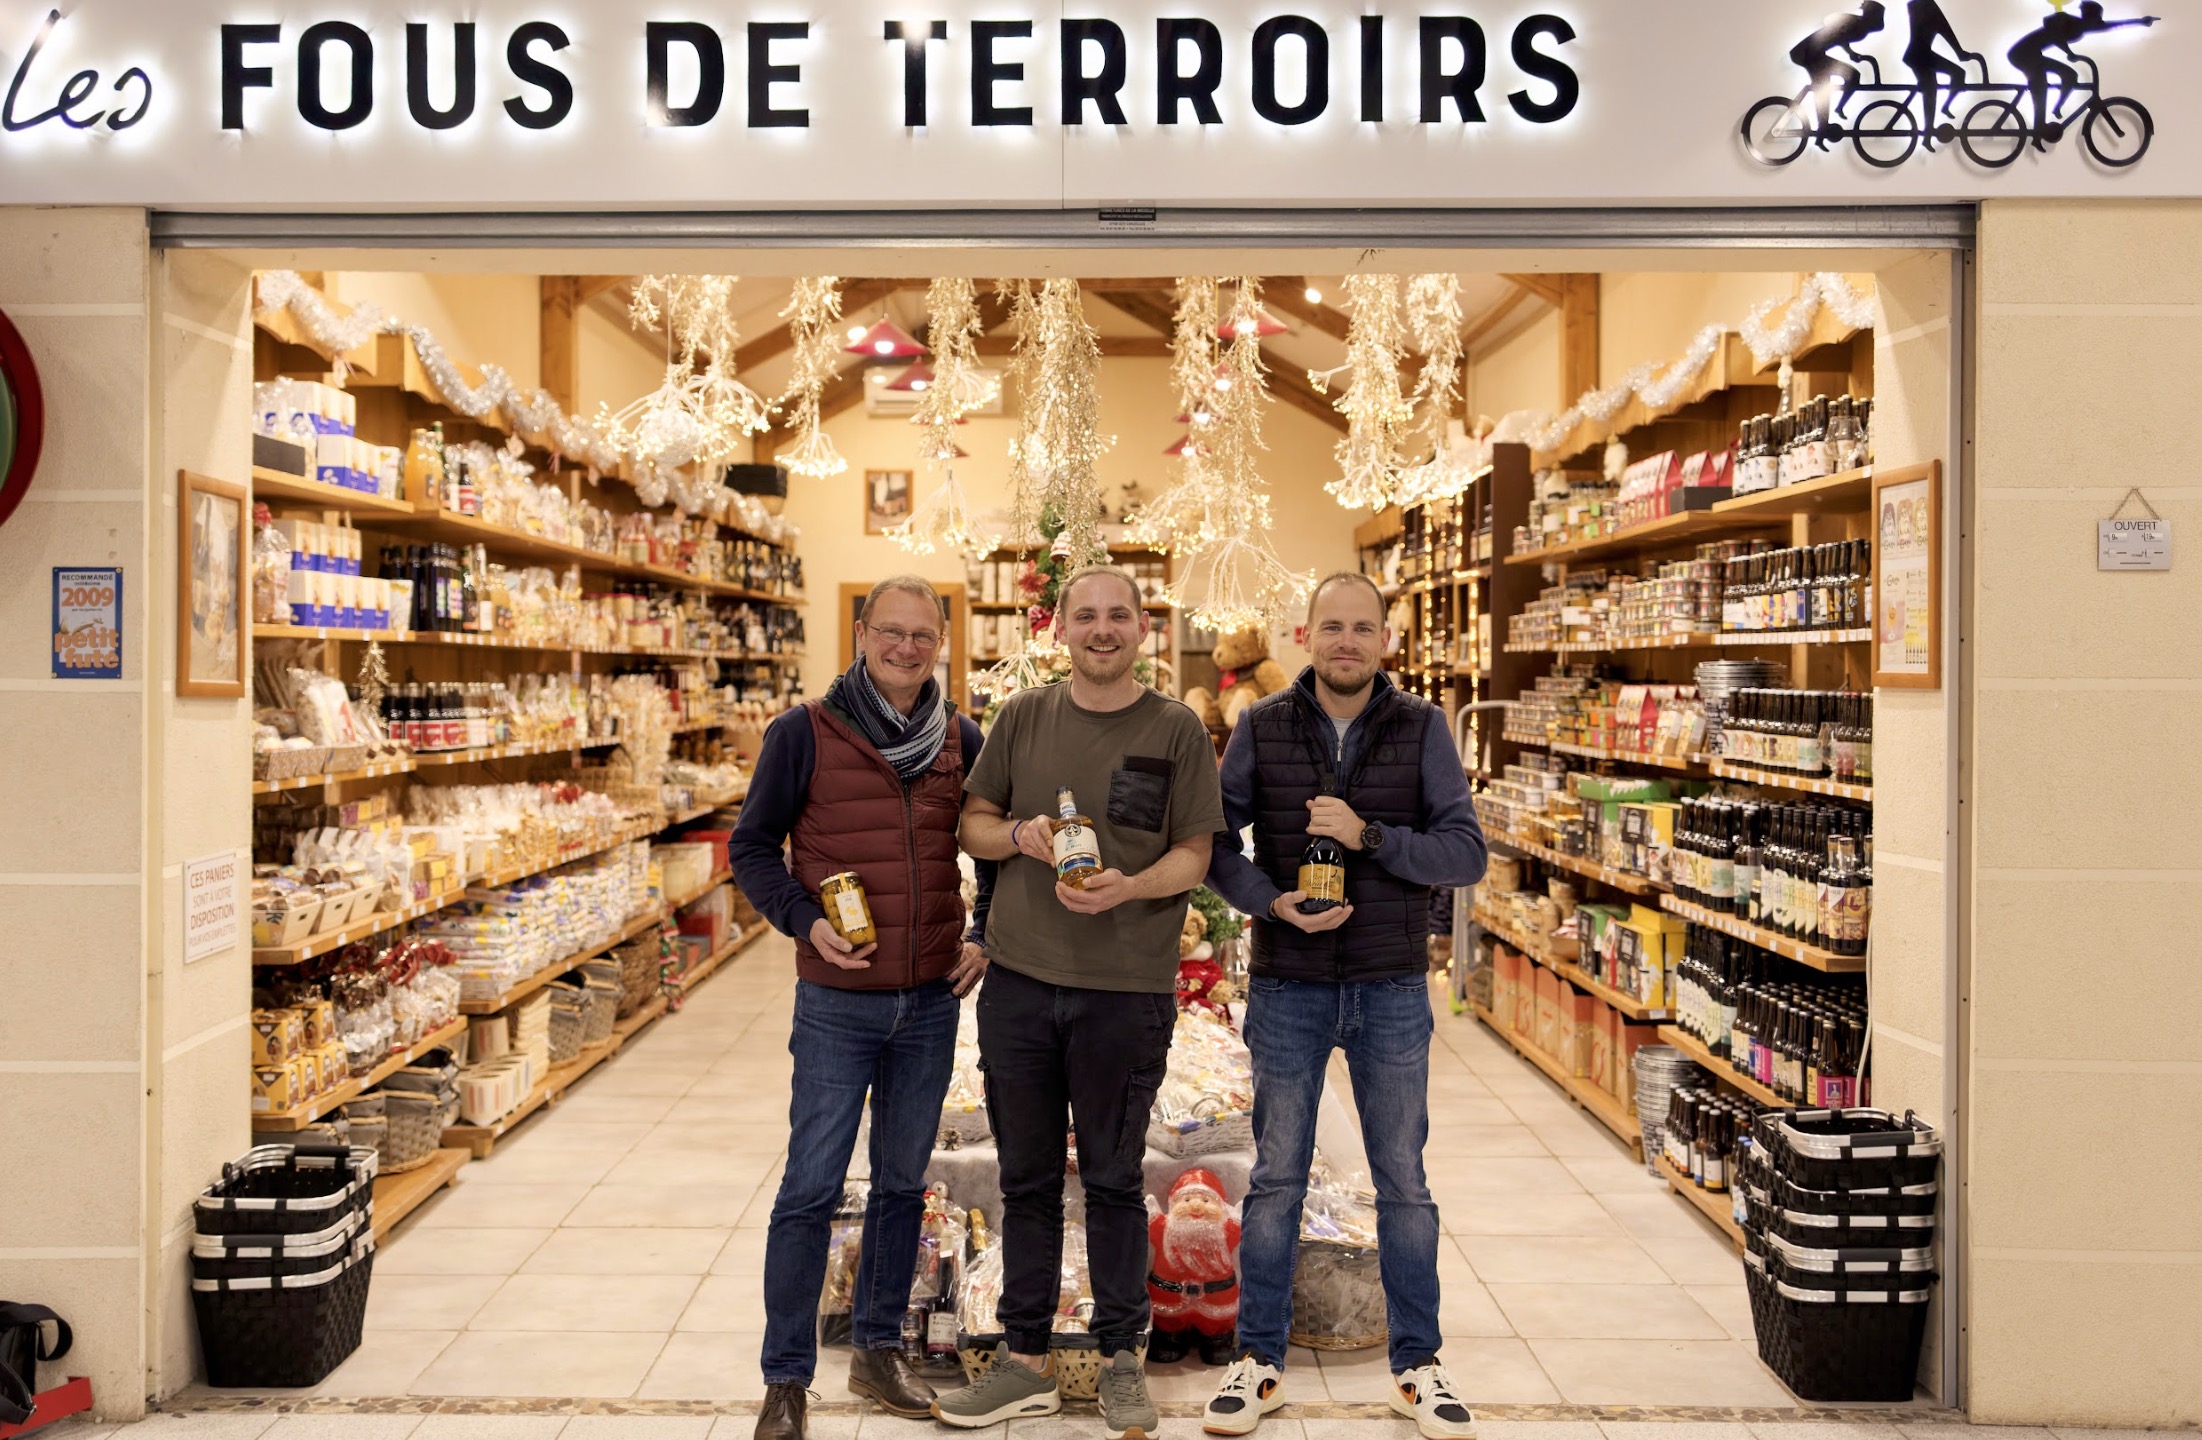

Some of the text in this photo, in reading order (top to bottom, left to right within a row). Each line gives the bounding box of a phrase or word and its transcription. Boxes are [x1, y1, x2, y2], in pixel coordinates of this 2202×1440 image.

[2, 9, 1580, 131] Les FOUS DE TERROIRS
[2114, 521, 2157, 531] OUVERT
[61, 573, 113, 581] RECOMMANDÉ
[61, 587, 114, 607] 2009
[54, 626, 119, 653] petit
[64, 647, 119, 669] futé
[190, 863, 235, 889] CES PANIERS
[193, 892, 209, 909] SONT
[214, 885, 232, 901] VOTRE
[190, 902, 235, 930] DISPOSITION
